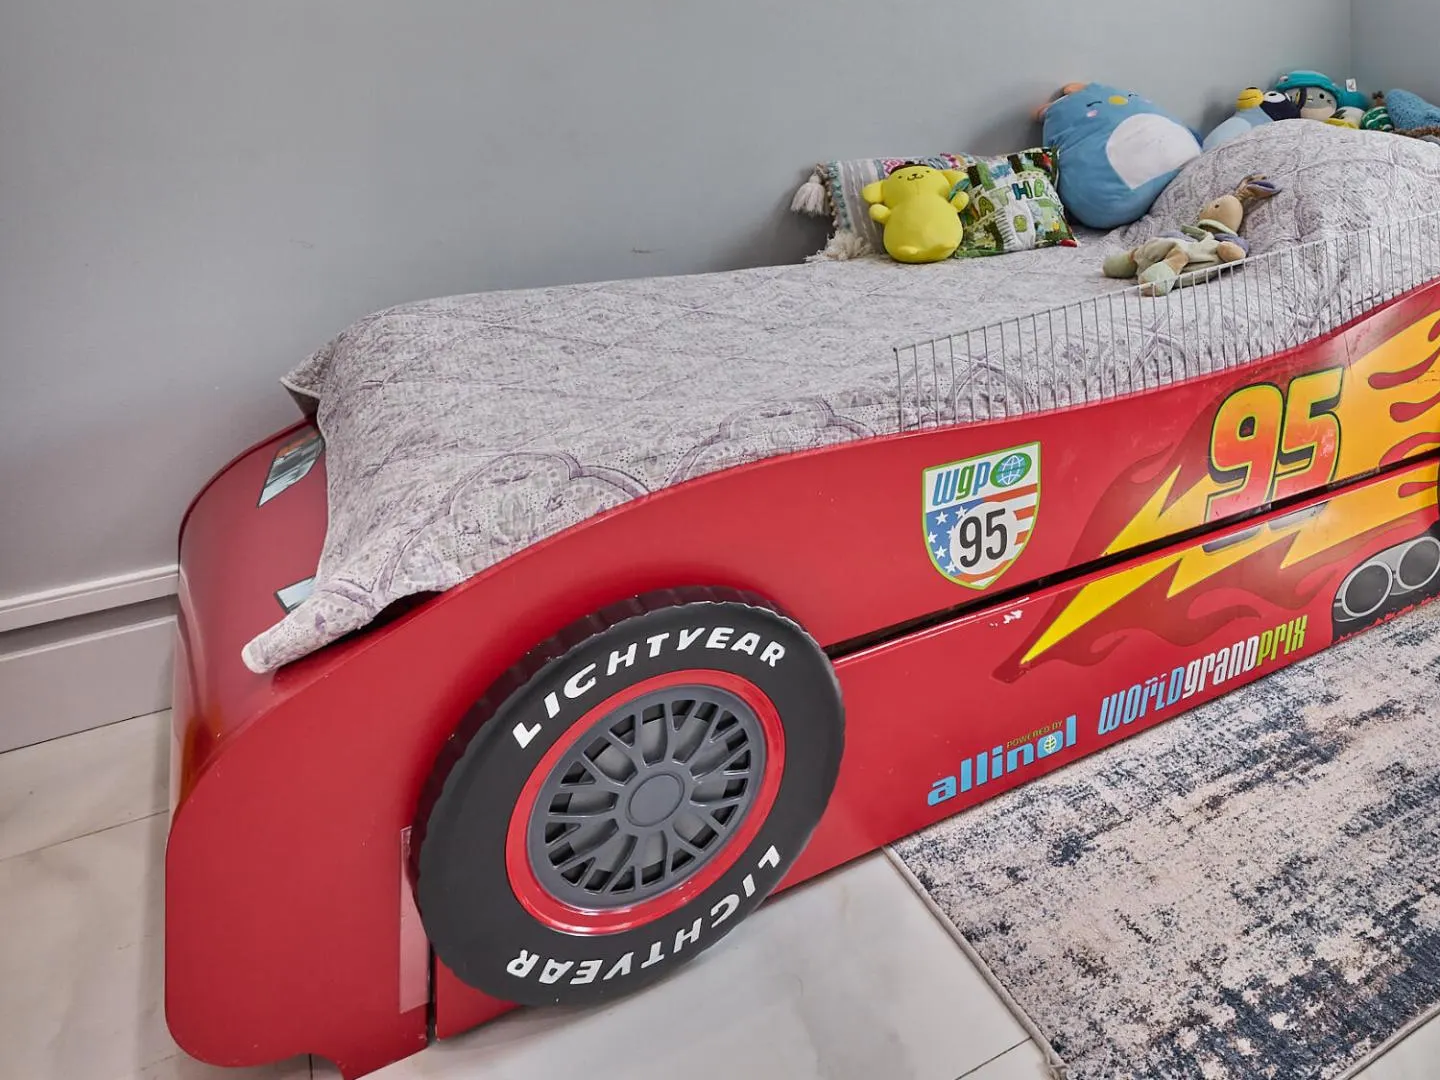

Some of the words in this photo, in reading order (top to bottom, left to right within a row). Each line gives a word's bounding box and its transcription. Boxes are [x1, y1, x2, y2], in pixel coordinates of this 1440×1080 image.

[932, 466, 991, 507] wgp
[1205, 366, 1344, 523] 95
[958, 507, 1008, 569] 95
[512, 626, 786, 749] LIGHTYEAR
[927, 715, 1078, 807] allinol
[506, 845, 781, 986] LIGHTYEAR
